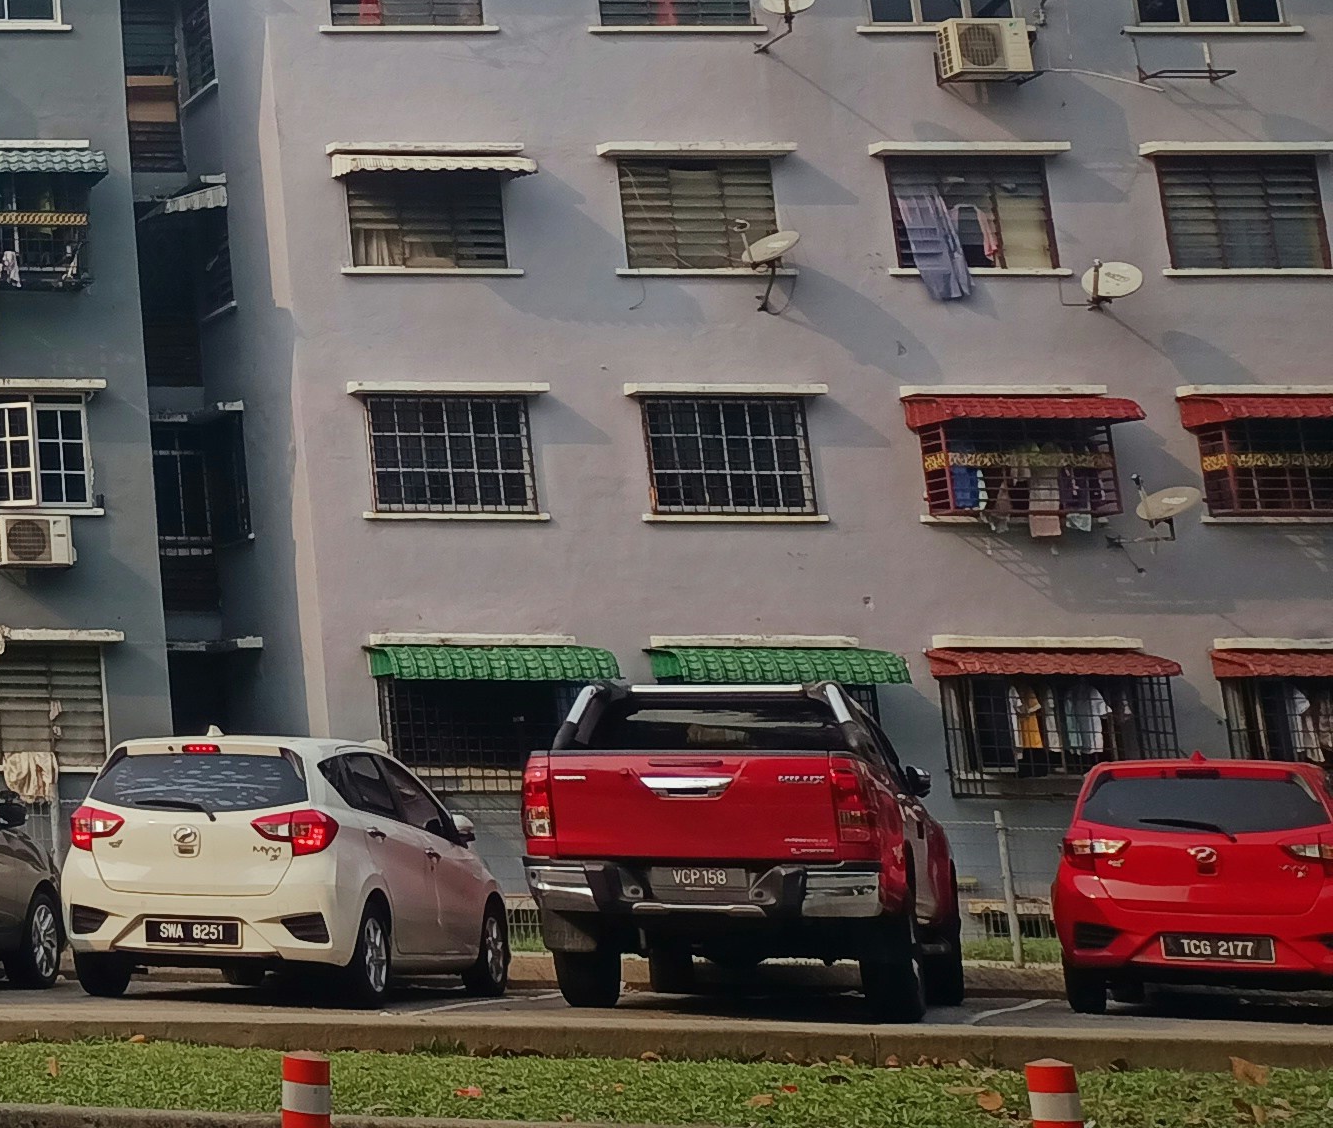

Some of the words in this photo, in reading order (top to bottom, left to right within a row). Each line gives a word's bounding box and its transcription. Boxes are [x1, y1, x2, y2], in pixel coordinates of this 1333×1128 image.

[673, 869, 700, 884] VCP
[702, 870, 727, 885] 158
[159, 923, 184, 938] SWA
[192, 924, 223, 940] 8251
[1180, 939, 1212, 955] TCG
[1217, 941, 1253, 956] 2177
